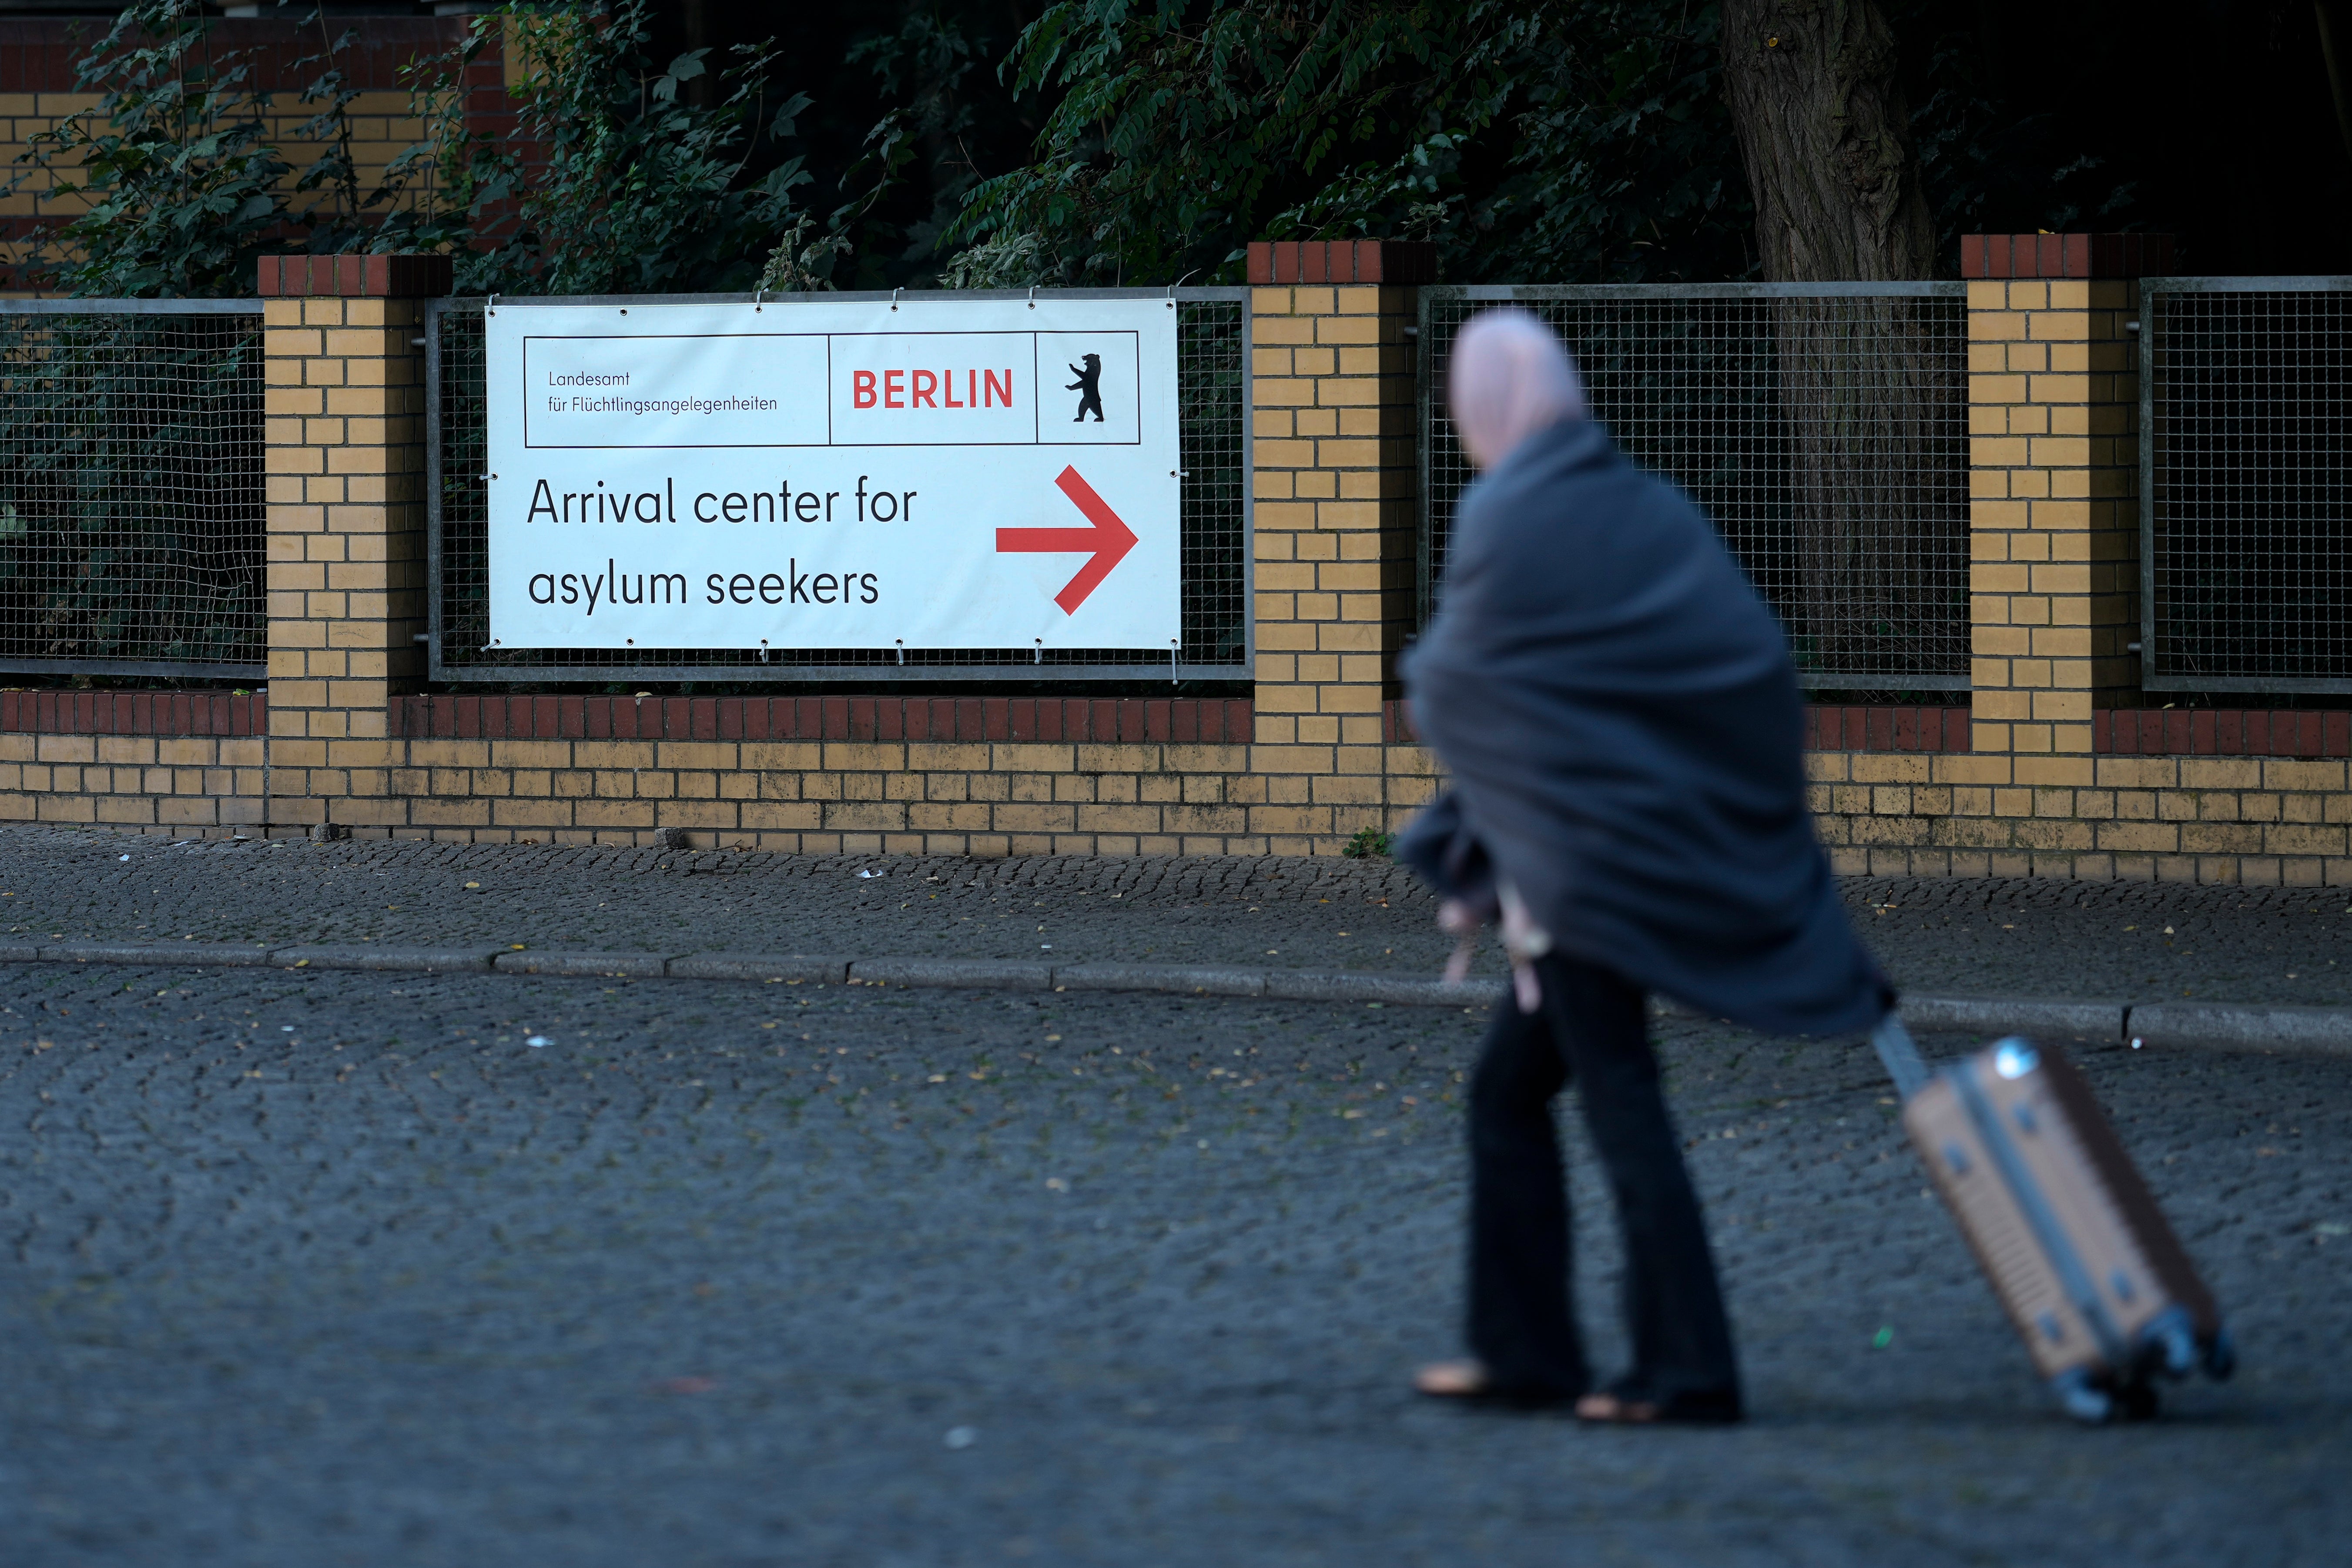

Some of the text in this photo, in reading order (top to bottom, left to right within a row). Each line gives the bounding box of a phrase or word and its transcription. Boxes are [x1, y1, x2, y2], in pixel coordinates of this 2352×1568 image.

[549, 371, 630, 386] Landesamt
[854, 369, 1012, 409] BERLIN
[548, 395, 777, 415] für Flüchtlingsangelegenheiten
[527, 476, 917, 523] Arrival center for
[529, 558, 878, 616] asylum seekers
